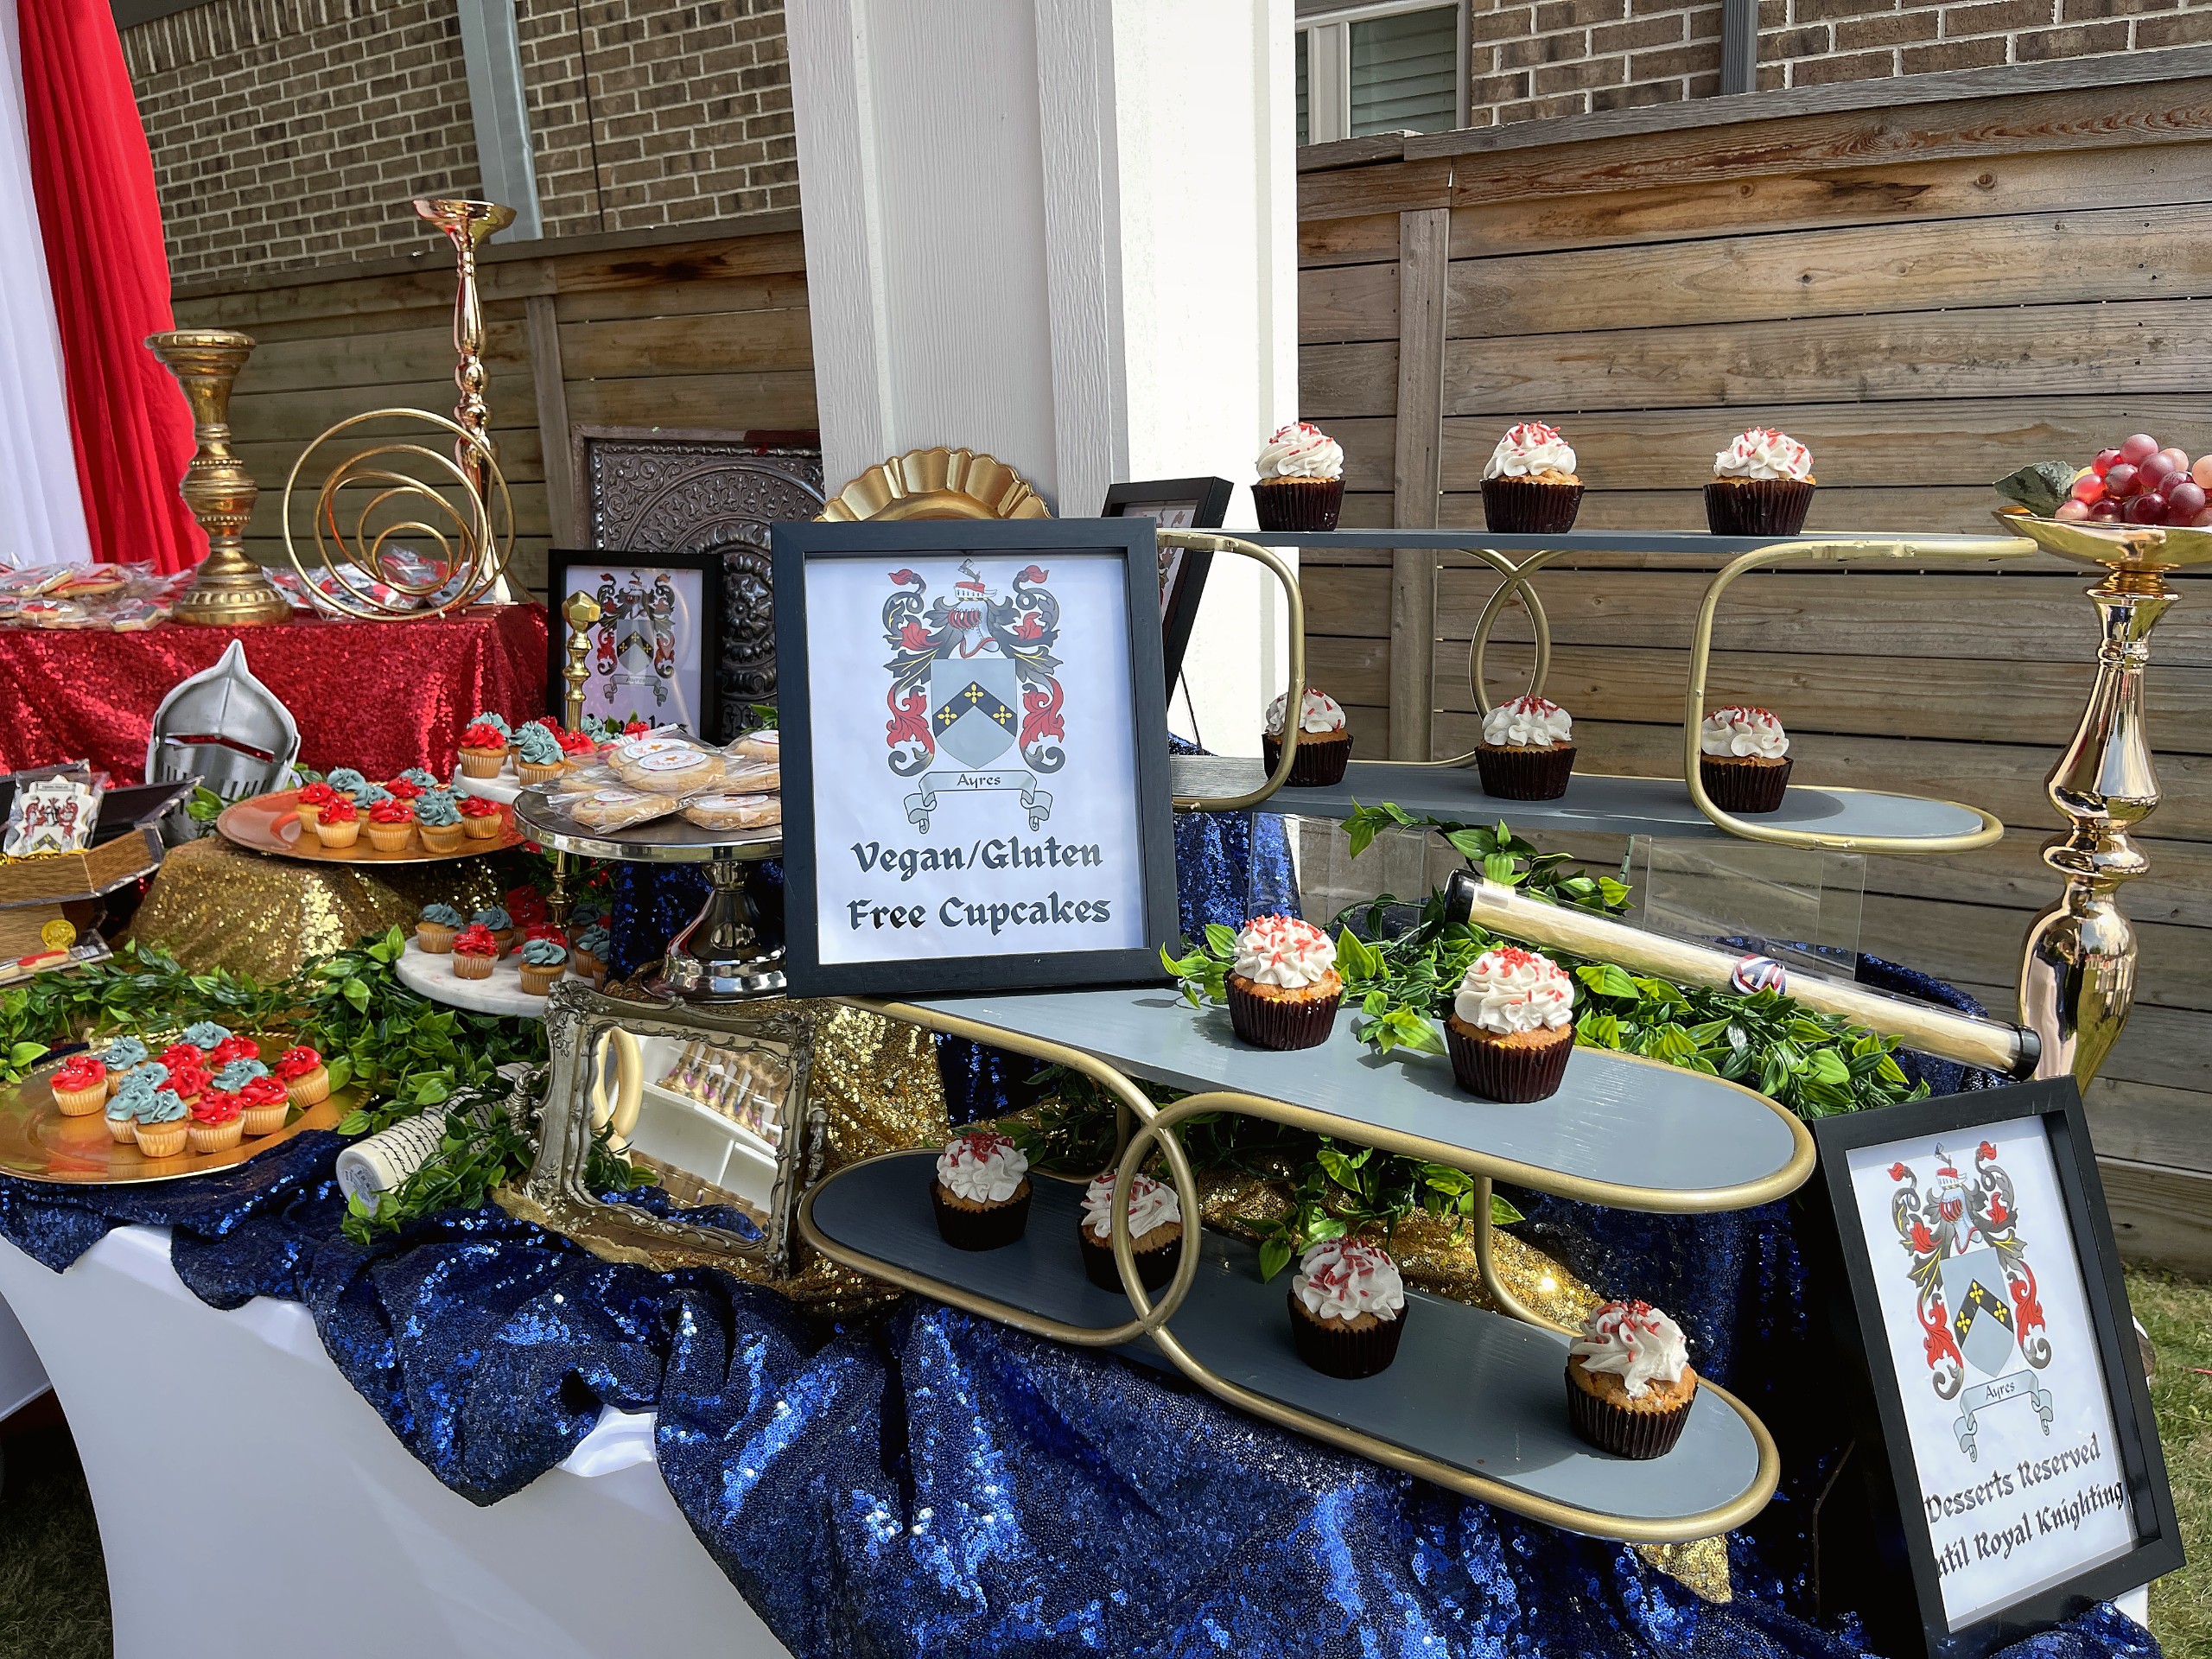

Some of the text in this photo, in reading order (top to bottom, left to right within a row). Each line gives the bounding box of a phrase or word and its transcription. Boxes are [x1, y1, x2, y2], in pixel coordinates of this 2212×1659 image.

[957, 773, 1001, 789] Ayres
[850, 836, 1103, 881] Vegan/Gluten
[846, 891, 1111, 936] Free Cupcakes
[1986, 1382, 2015, 1400] Ayres
[1924, 1432, 2101, 1523] Desserts Reserved
[1936, 1481, 2123, 1578] ntil Royal Knighting
